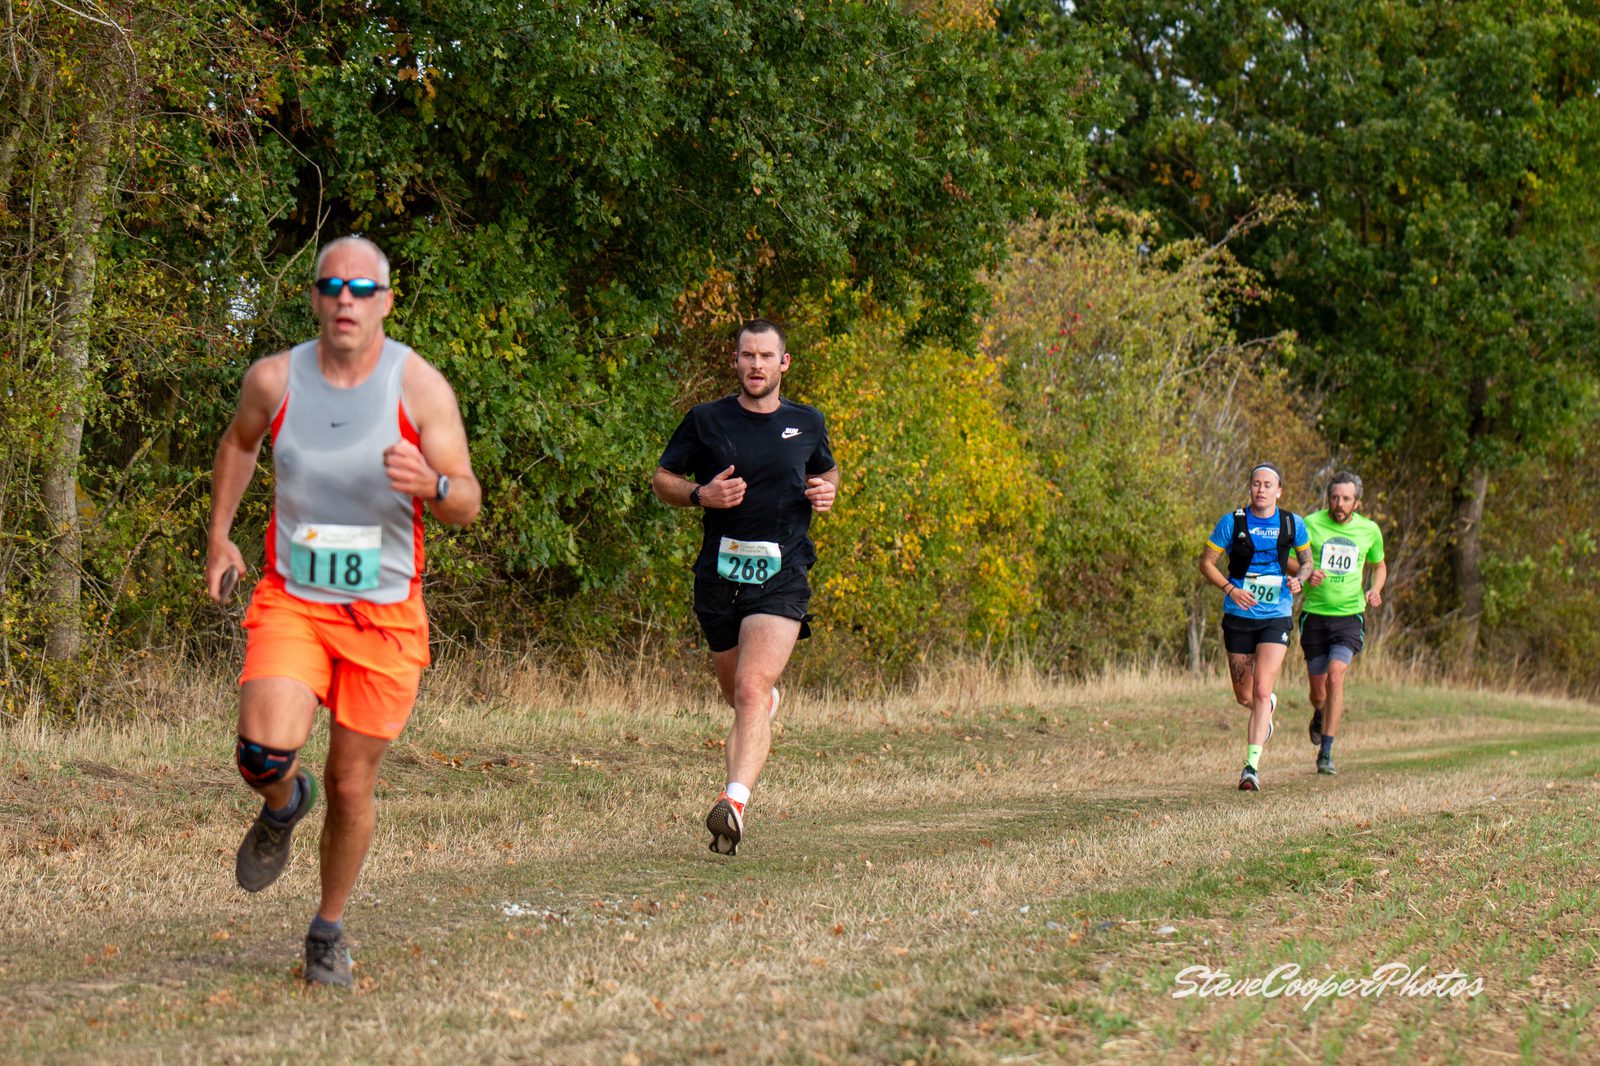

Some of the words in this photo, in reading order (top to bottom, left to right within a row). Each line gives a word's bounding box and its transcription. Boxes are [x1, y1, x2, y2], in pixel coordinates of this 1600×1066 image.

[310, 550, 362, 586] 118
[728, 556, 768, 582] 268
[1328, 555, 1351, 570] 440
